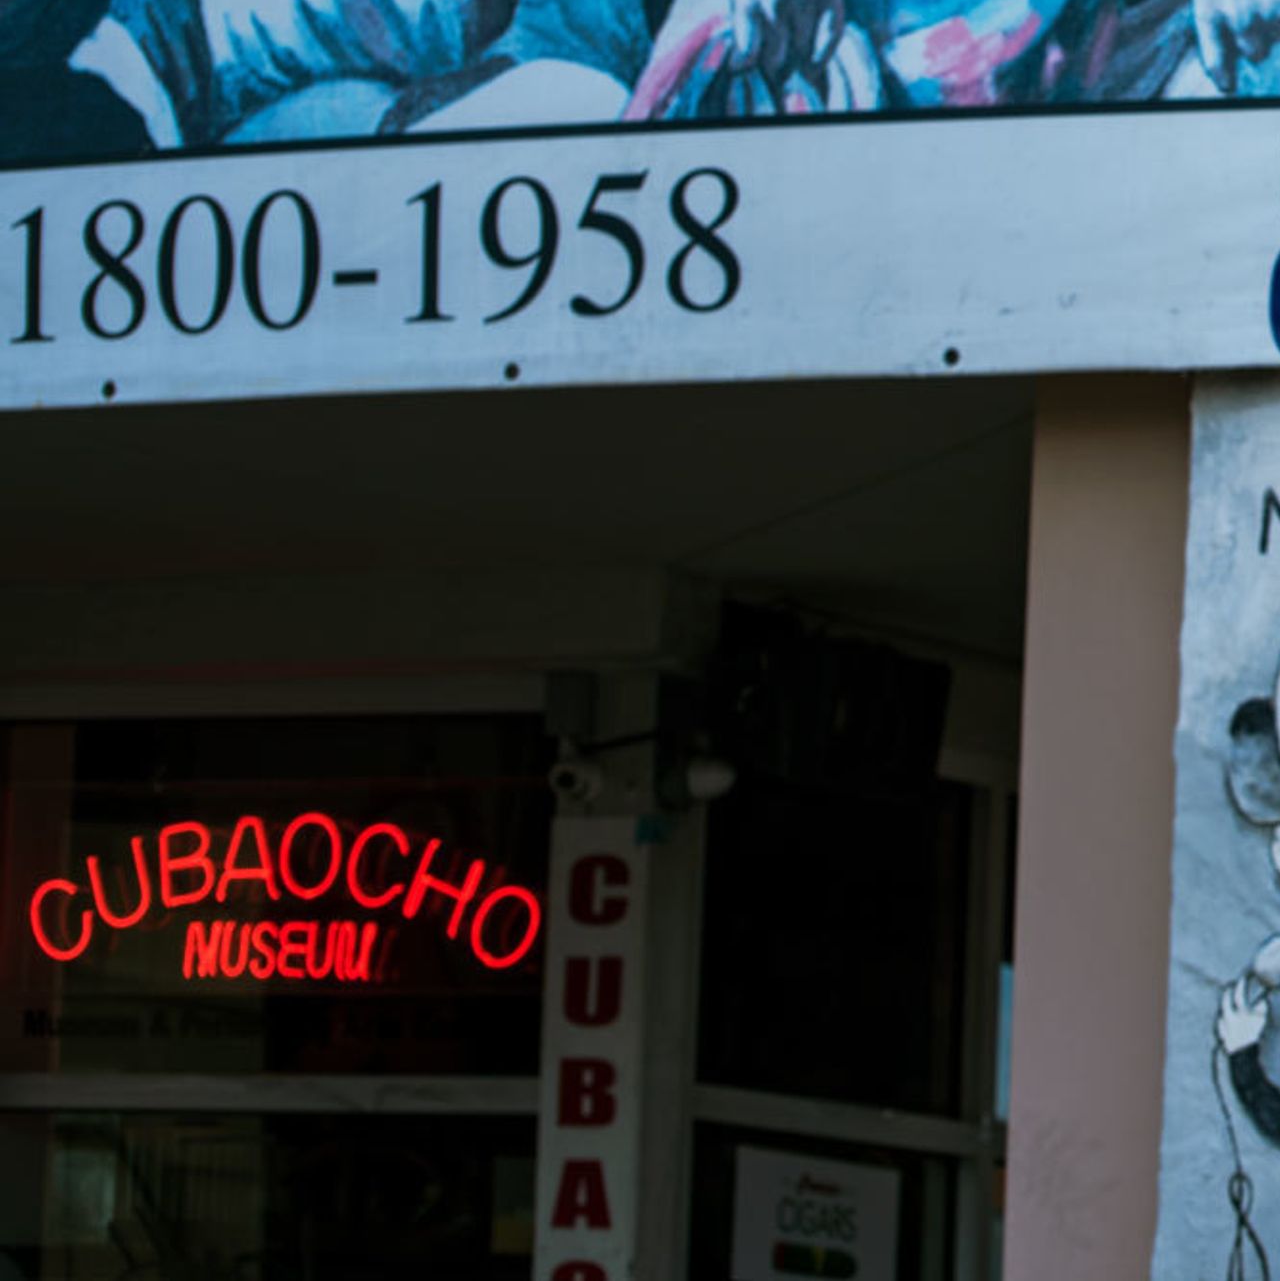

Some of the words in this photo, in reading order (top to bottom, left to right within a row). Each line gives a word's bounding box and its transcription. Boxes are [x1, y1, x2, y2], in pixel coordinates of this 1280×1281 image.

[8, 167, 742, 344] 1800-1958
[29, 812, 541, 969] CUBAOCHO
[182, 920, 379, 981] MUSEUM
